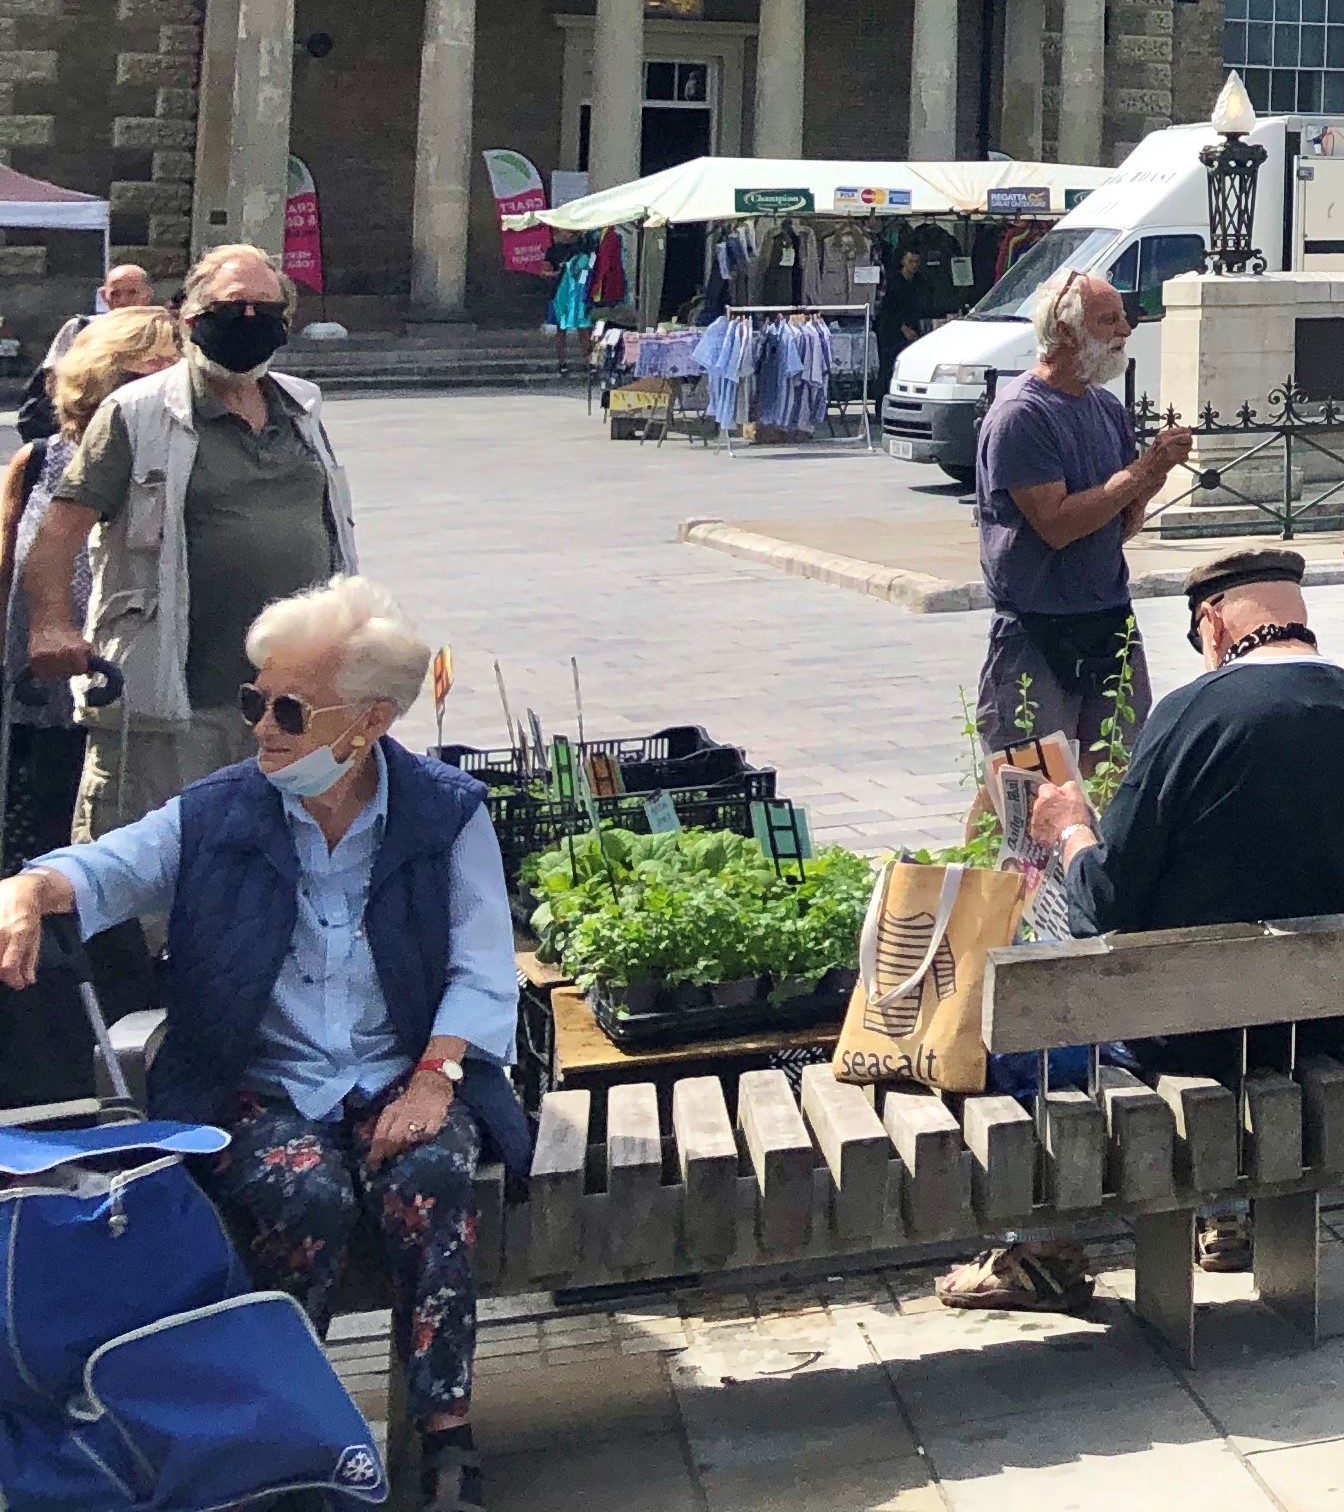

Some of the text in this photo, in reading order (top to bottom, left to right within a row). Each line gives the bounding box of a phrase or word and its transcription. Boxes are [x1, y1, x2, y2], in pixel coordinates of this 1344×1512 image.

[990, 193, 1027, 201] REGATTA
[1006, 814, 1025, 852] Daily
[841, 1044, 938, 1082] seasalt
